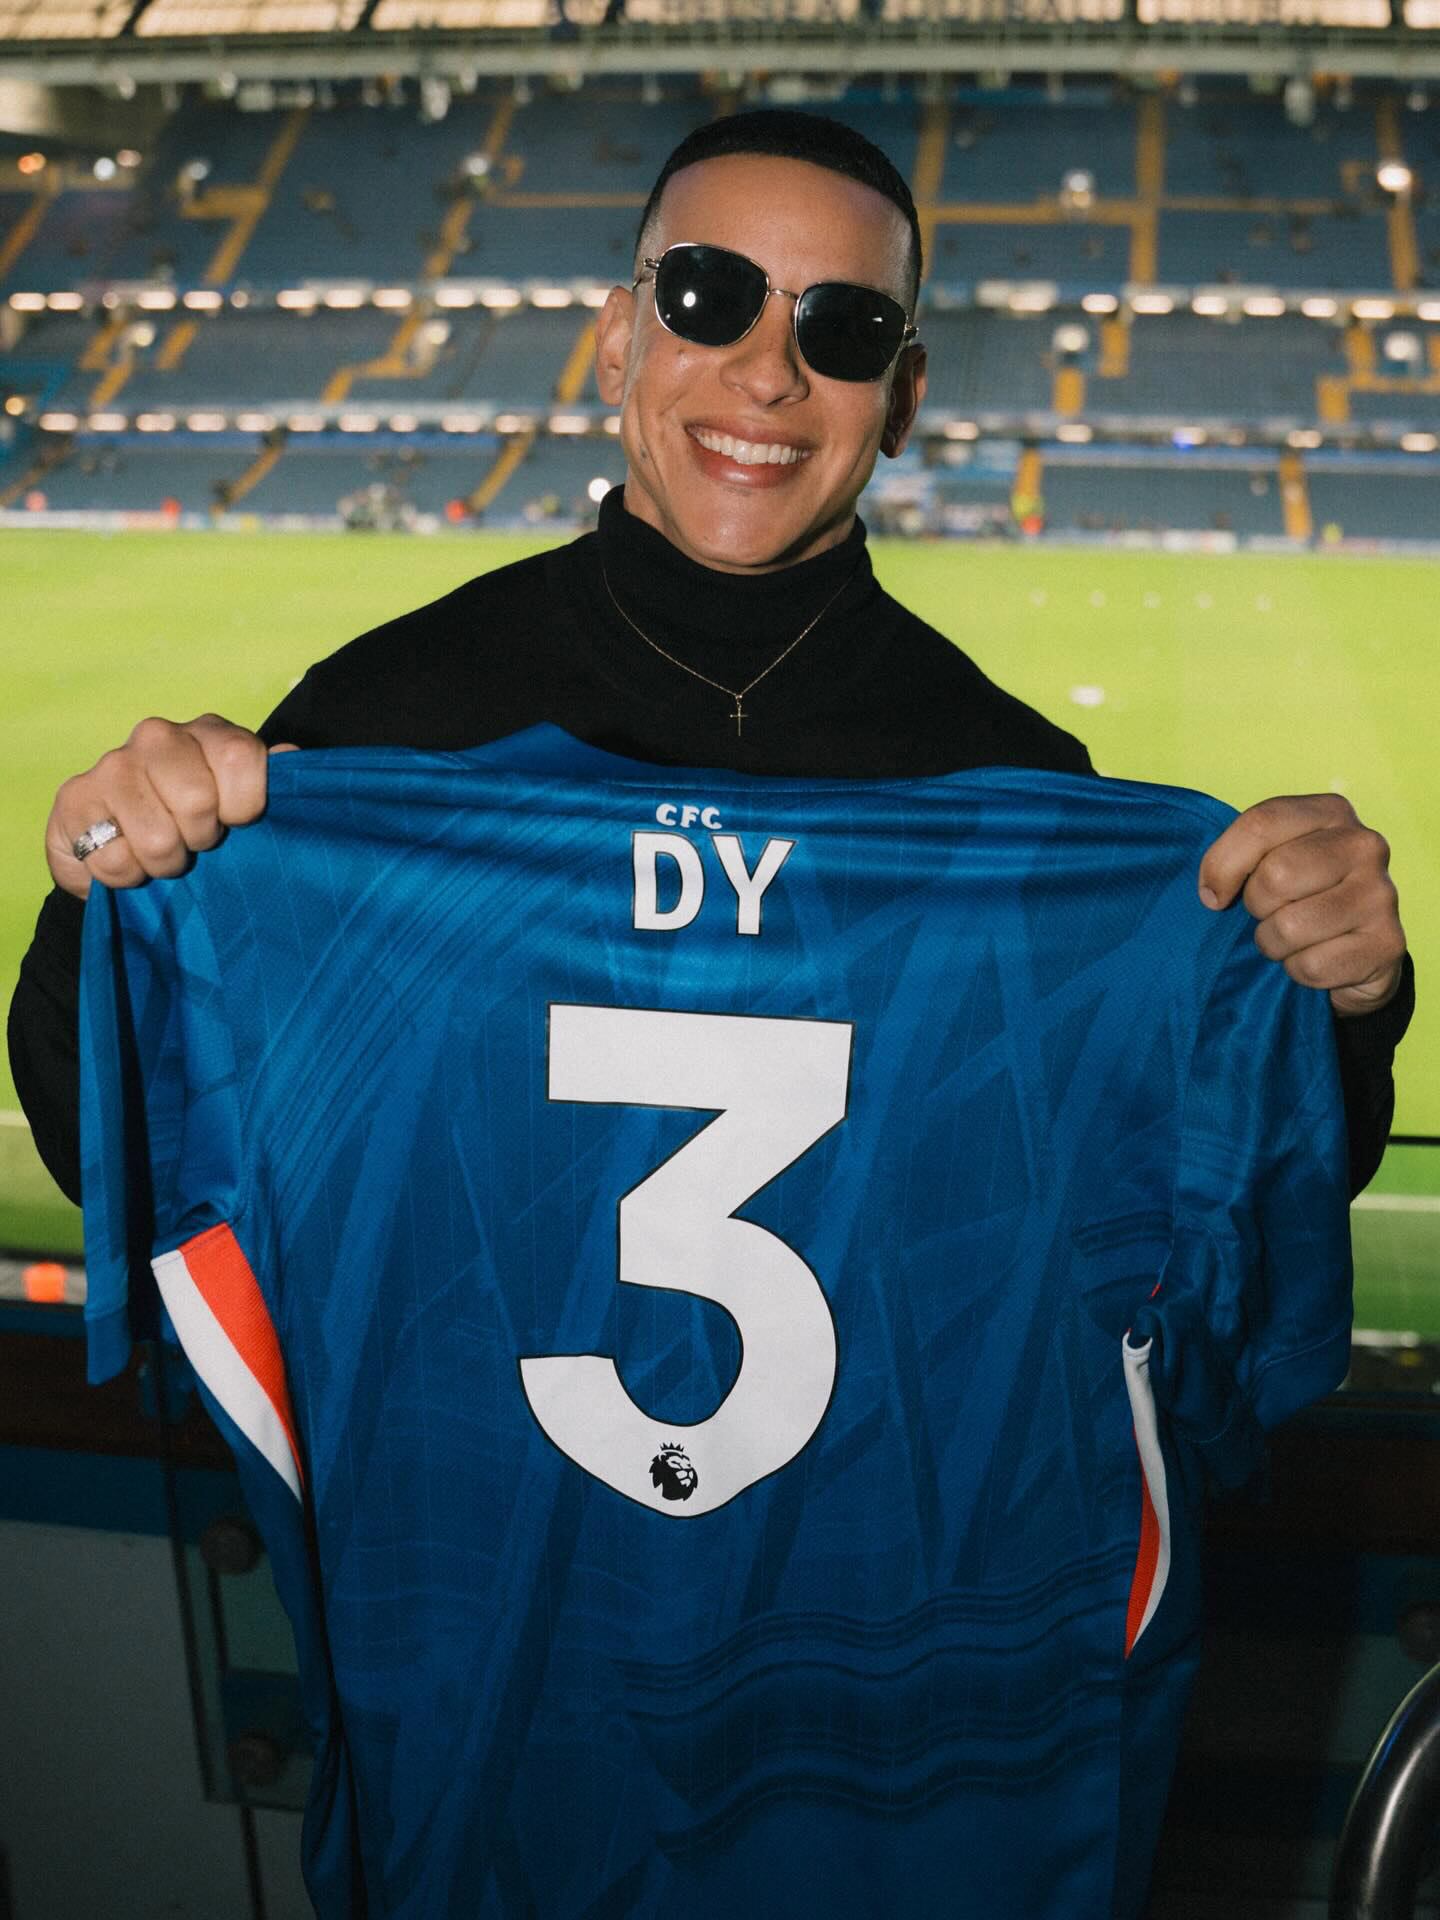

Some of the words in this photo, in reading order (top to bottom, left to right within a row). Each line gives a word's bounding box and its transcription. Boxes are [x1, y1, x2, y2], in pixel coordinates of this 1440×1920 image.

[655, 803, 722, 829] CFC
[632, 831, 795, 936] DY
[518, 1002, 854, 1518] 3
